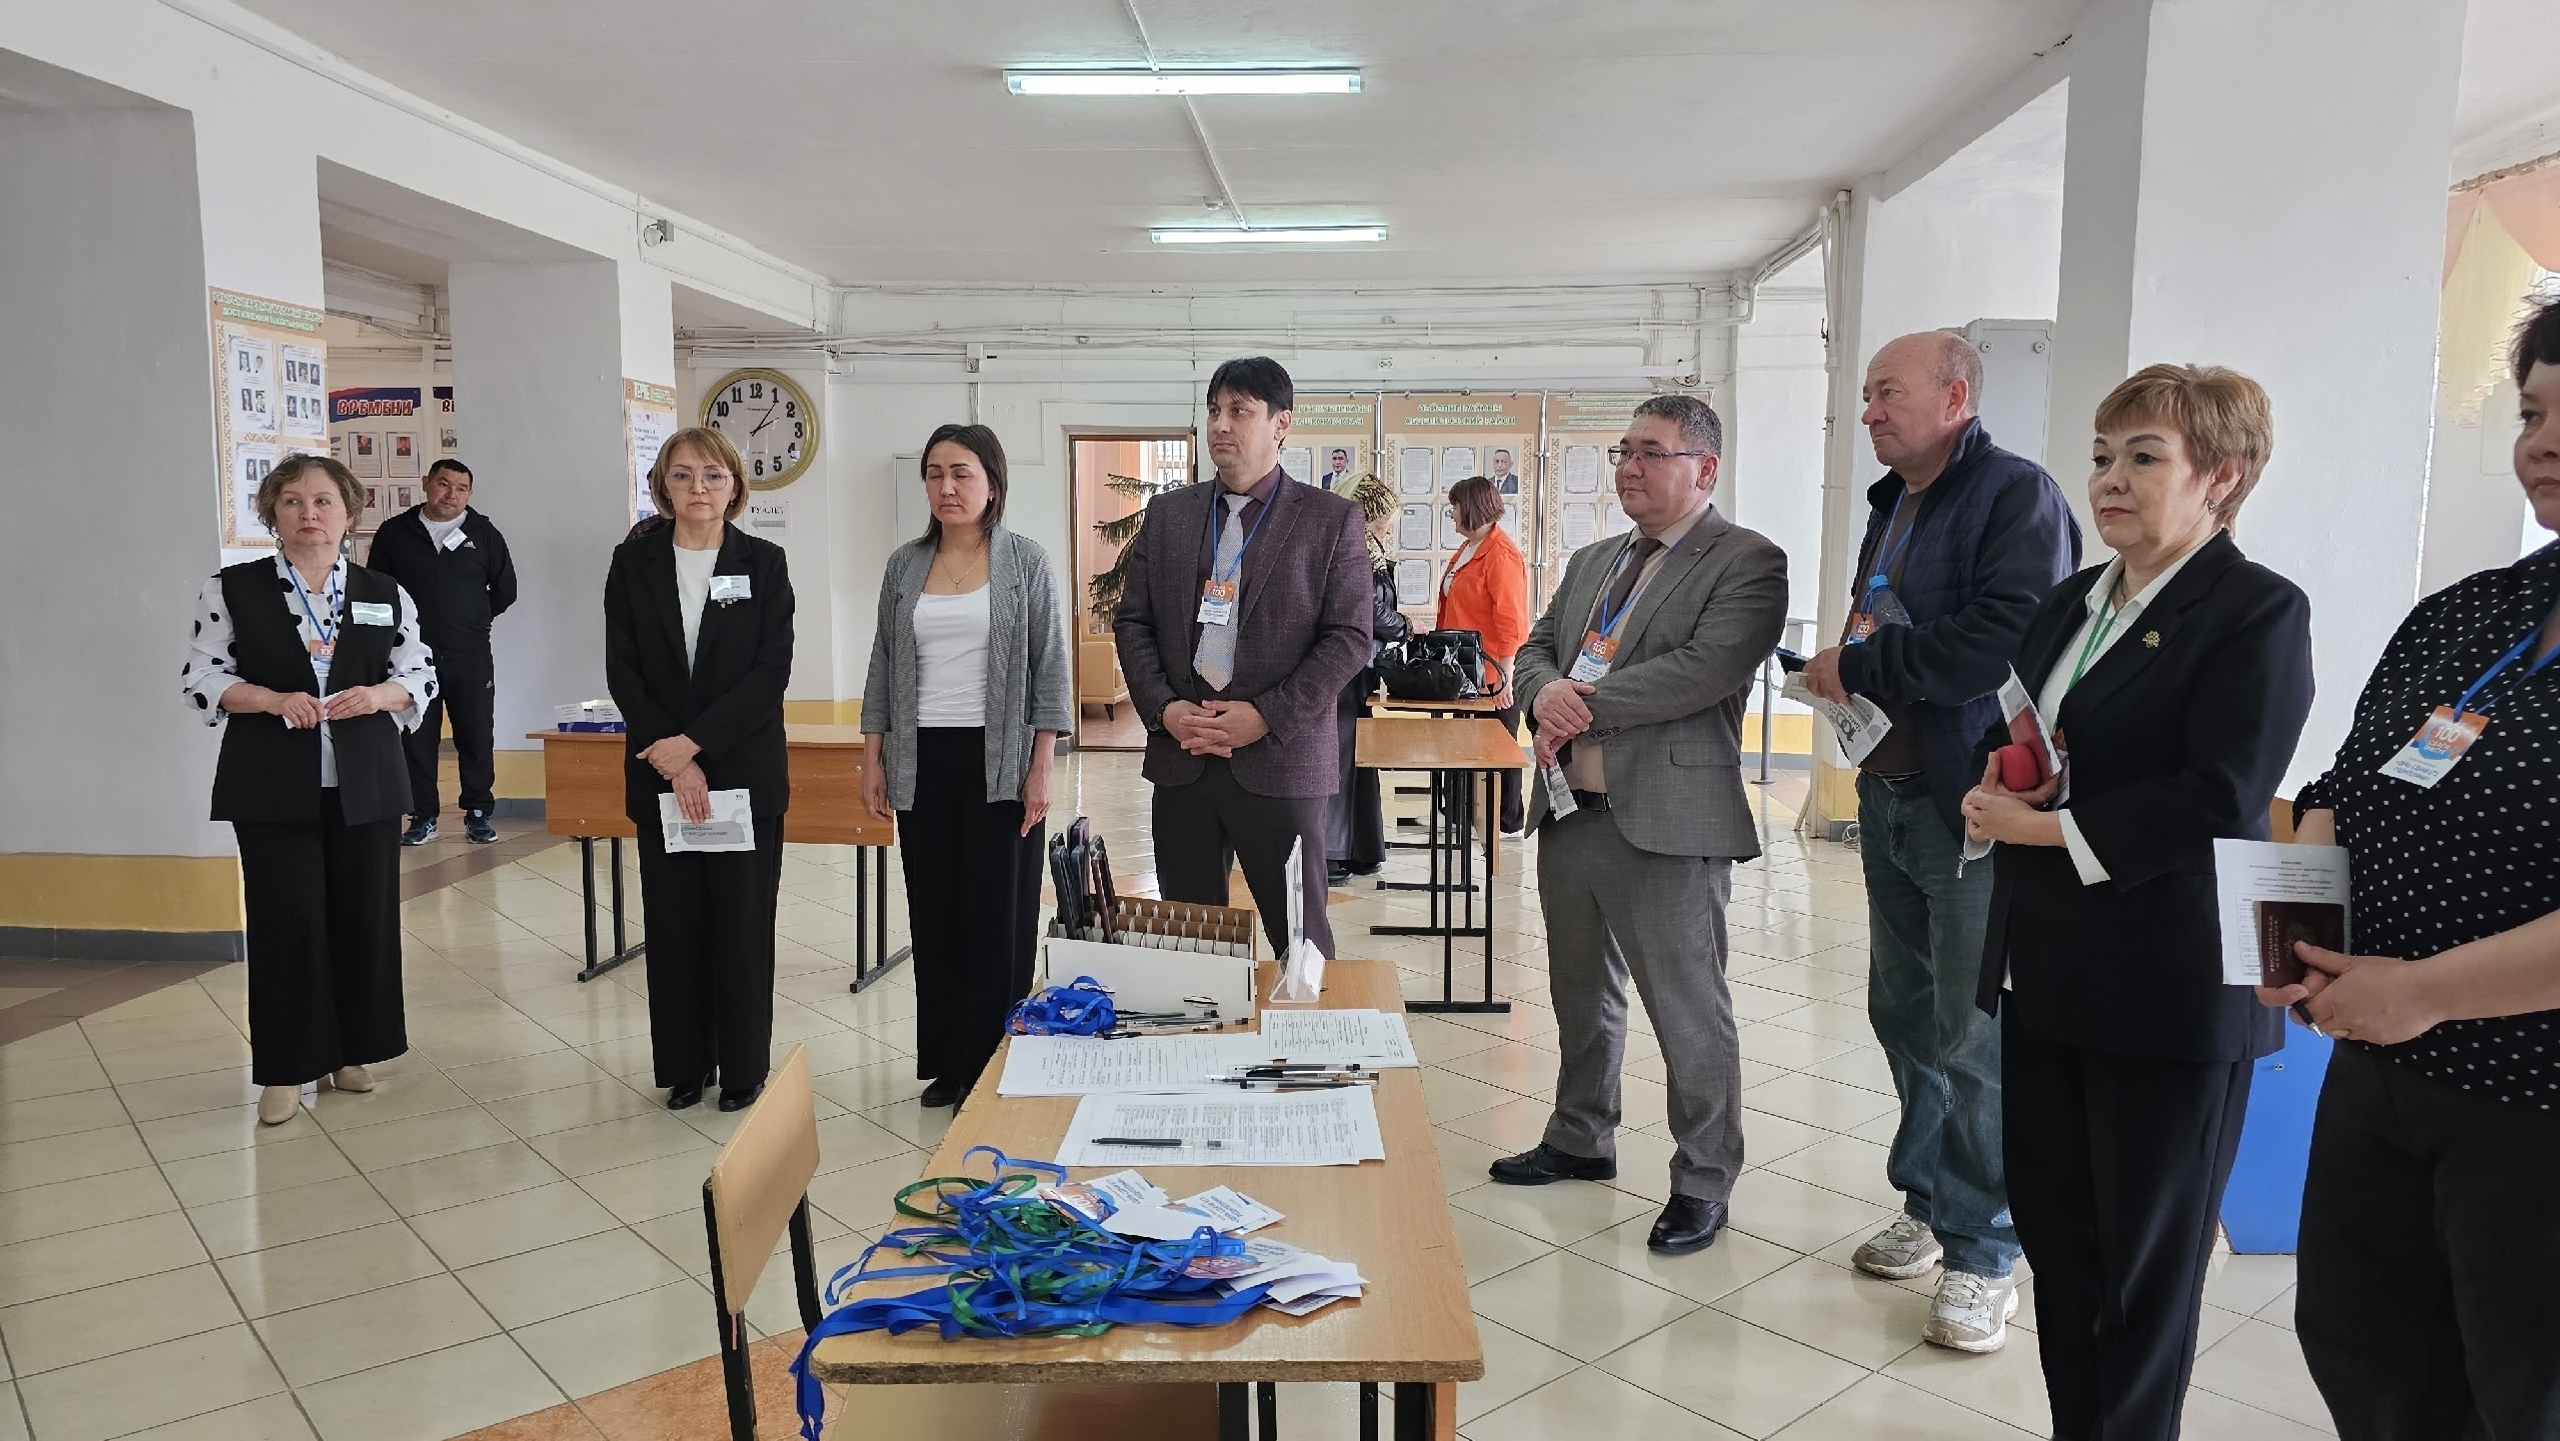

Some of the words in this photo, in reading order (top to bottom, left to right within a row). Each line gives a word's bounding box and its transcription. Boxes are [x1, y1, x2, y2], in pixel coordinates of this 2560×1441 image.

[223, 307, 269, 323] ДОСТИЖЕНИЯ
[269, 316, 315, 333] ШКОЛЬНИКОВ
[731, 386, 744, 403] 11
[749, 382, 763, 399] 12
[772, 387, 779, 403] 1
[336, 399, 414, 416] ВРЕМЕНИ
[716, 401, 729, 417] 10
[785, 401, 796, 418] 2
[1292, 417, 1364, 426] БАШКОРТОСТАН
[1484, 415, 1516, 425] РАЙОН
[794, 421, 803, 438] 3
[754, 459, 763, 476] 6
[773, 455, 782, 472] 5
[750, 506, 785, 514] ТУАЛЕТ
[1857, 623, 1870, 635] 100
[1592, 642, 1606, 655] 100
[2434, 726, 2460, 743] 100
